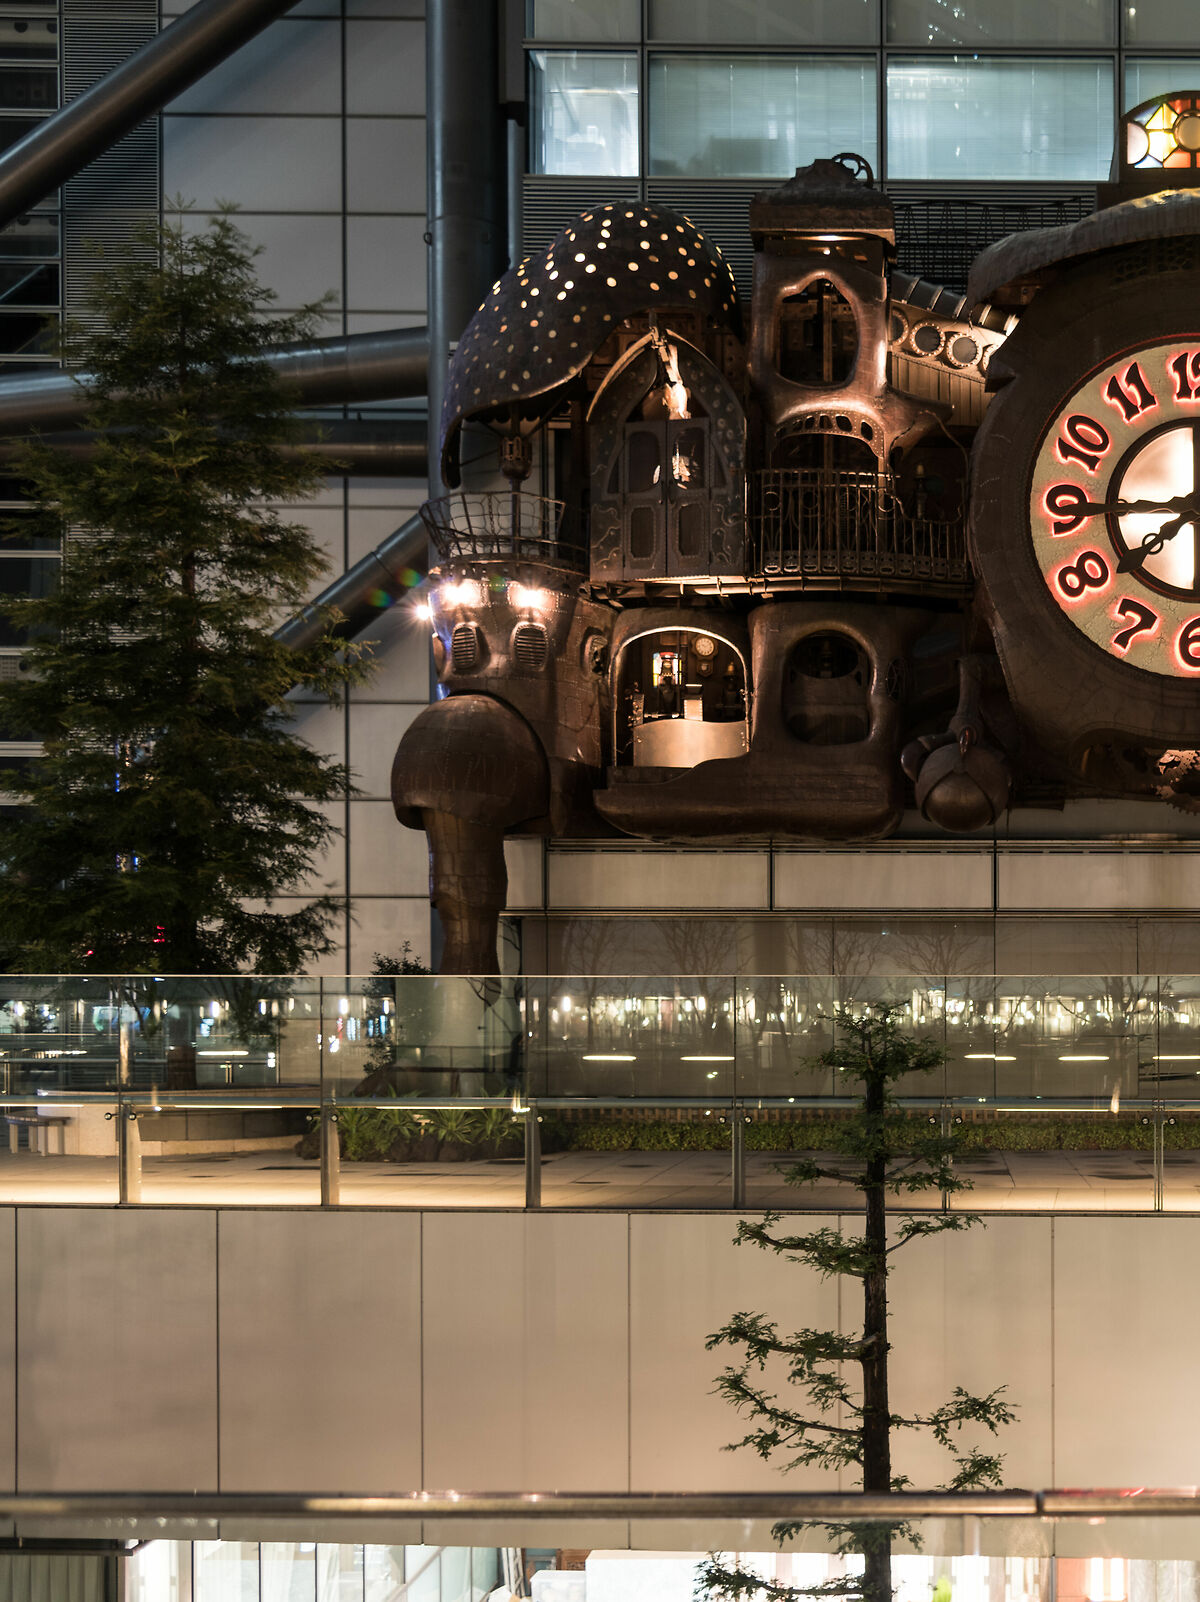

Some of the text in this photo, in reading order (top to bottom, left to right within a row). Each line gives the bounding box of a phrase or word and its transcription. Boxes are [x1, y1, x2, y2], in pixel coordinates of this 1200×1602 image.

[1106, 361, 1157, 422] 11
[1058, 415, 1110, 471] 10
[1046, 484, 1088, 535] 9
[1058, 551, 1109, 598] 8
[1112, 598, 1158, 650] 7
